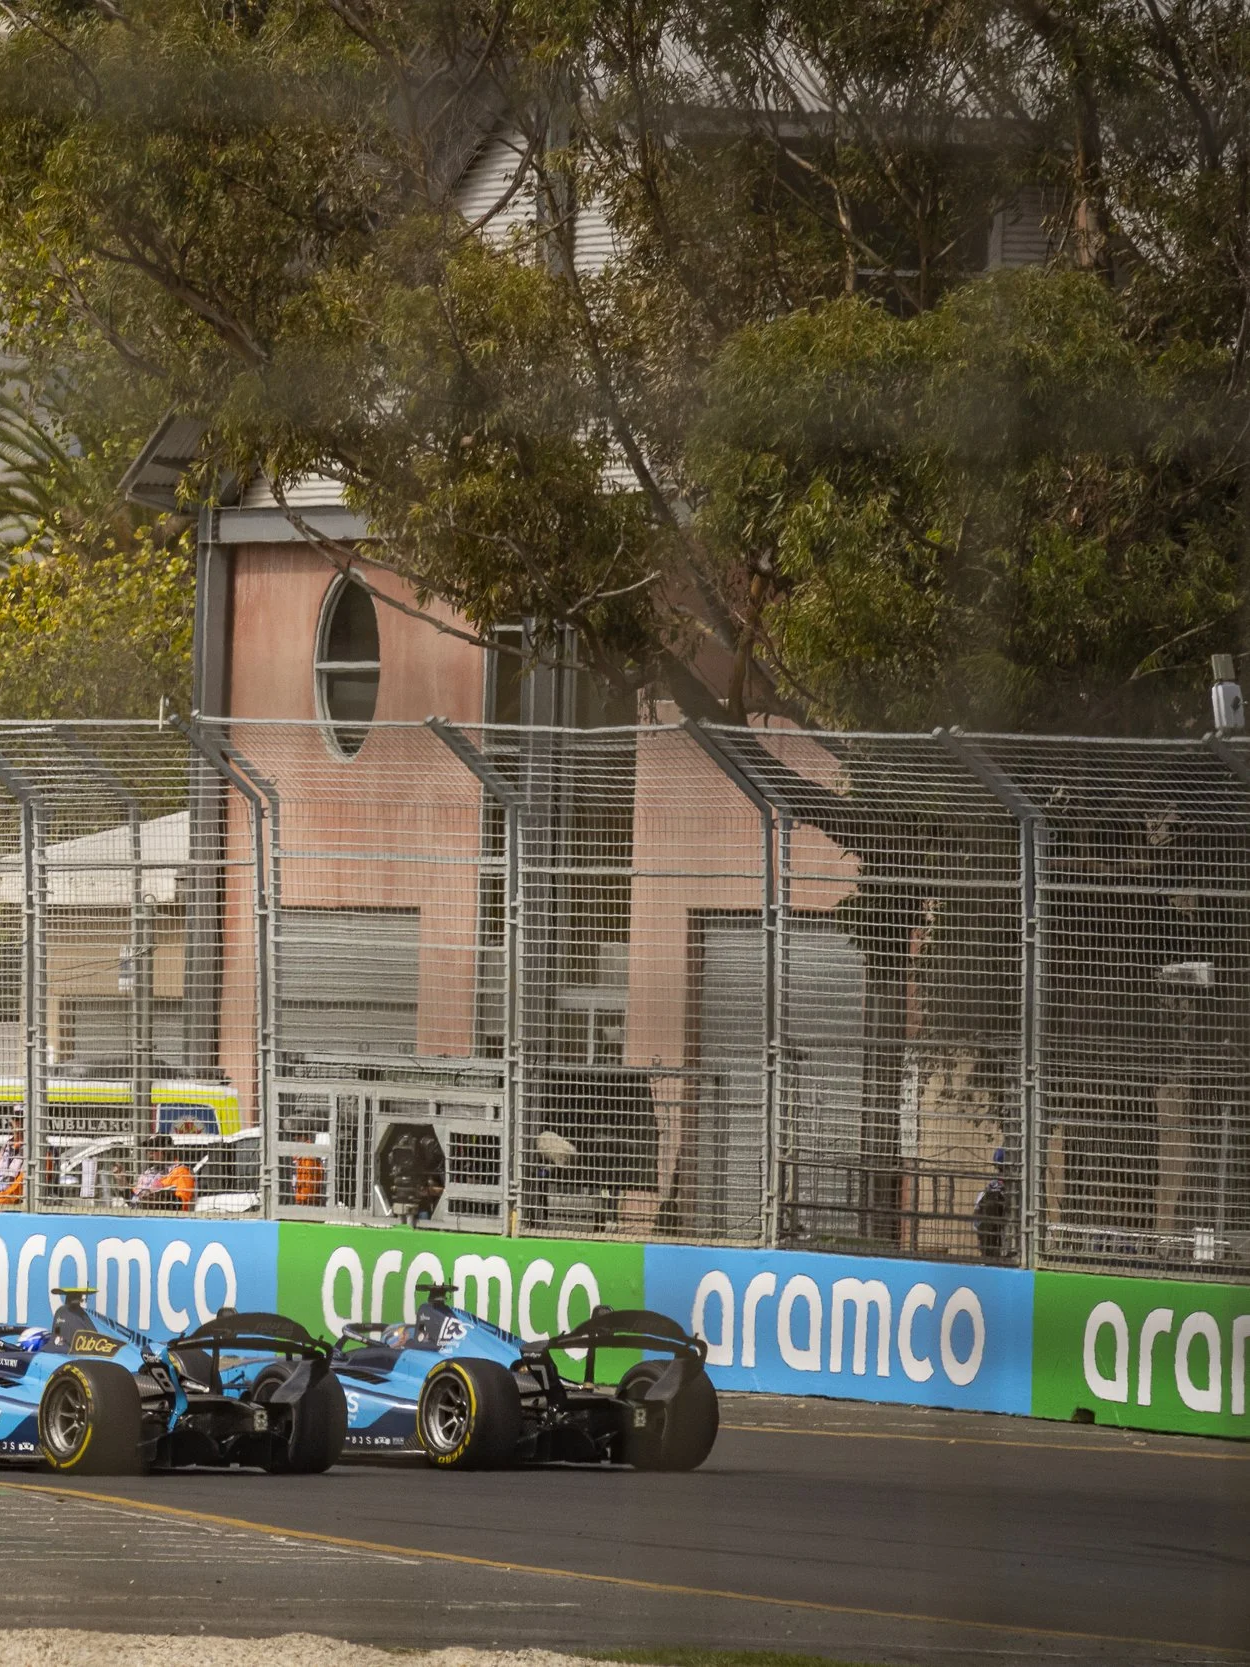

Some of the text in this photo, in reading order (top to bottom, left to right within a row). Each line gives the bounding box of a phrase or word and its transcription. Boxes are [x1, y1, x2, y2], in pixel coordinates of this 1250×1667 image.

[322, 1246, 600, 1360] aramco
[691, 1270, 985, 1386] aramco
[75, 1337, 118, 1353] Club Car
[151, 1367, 175, 1393] 8
